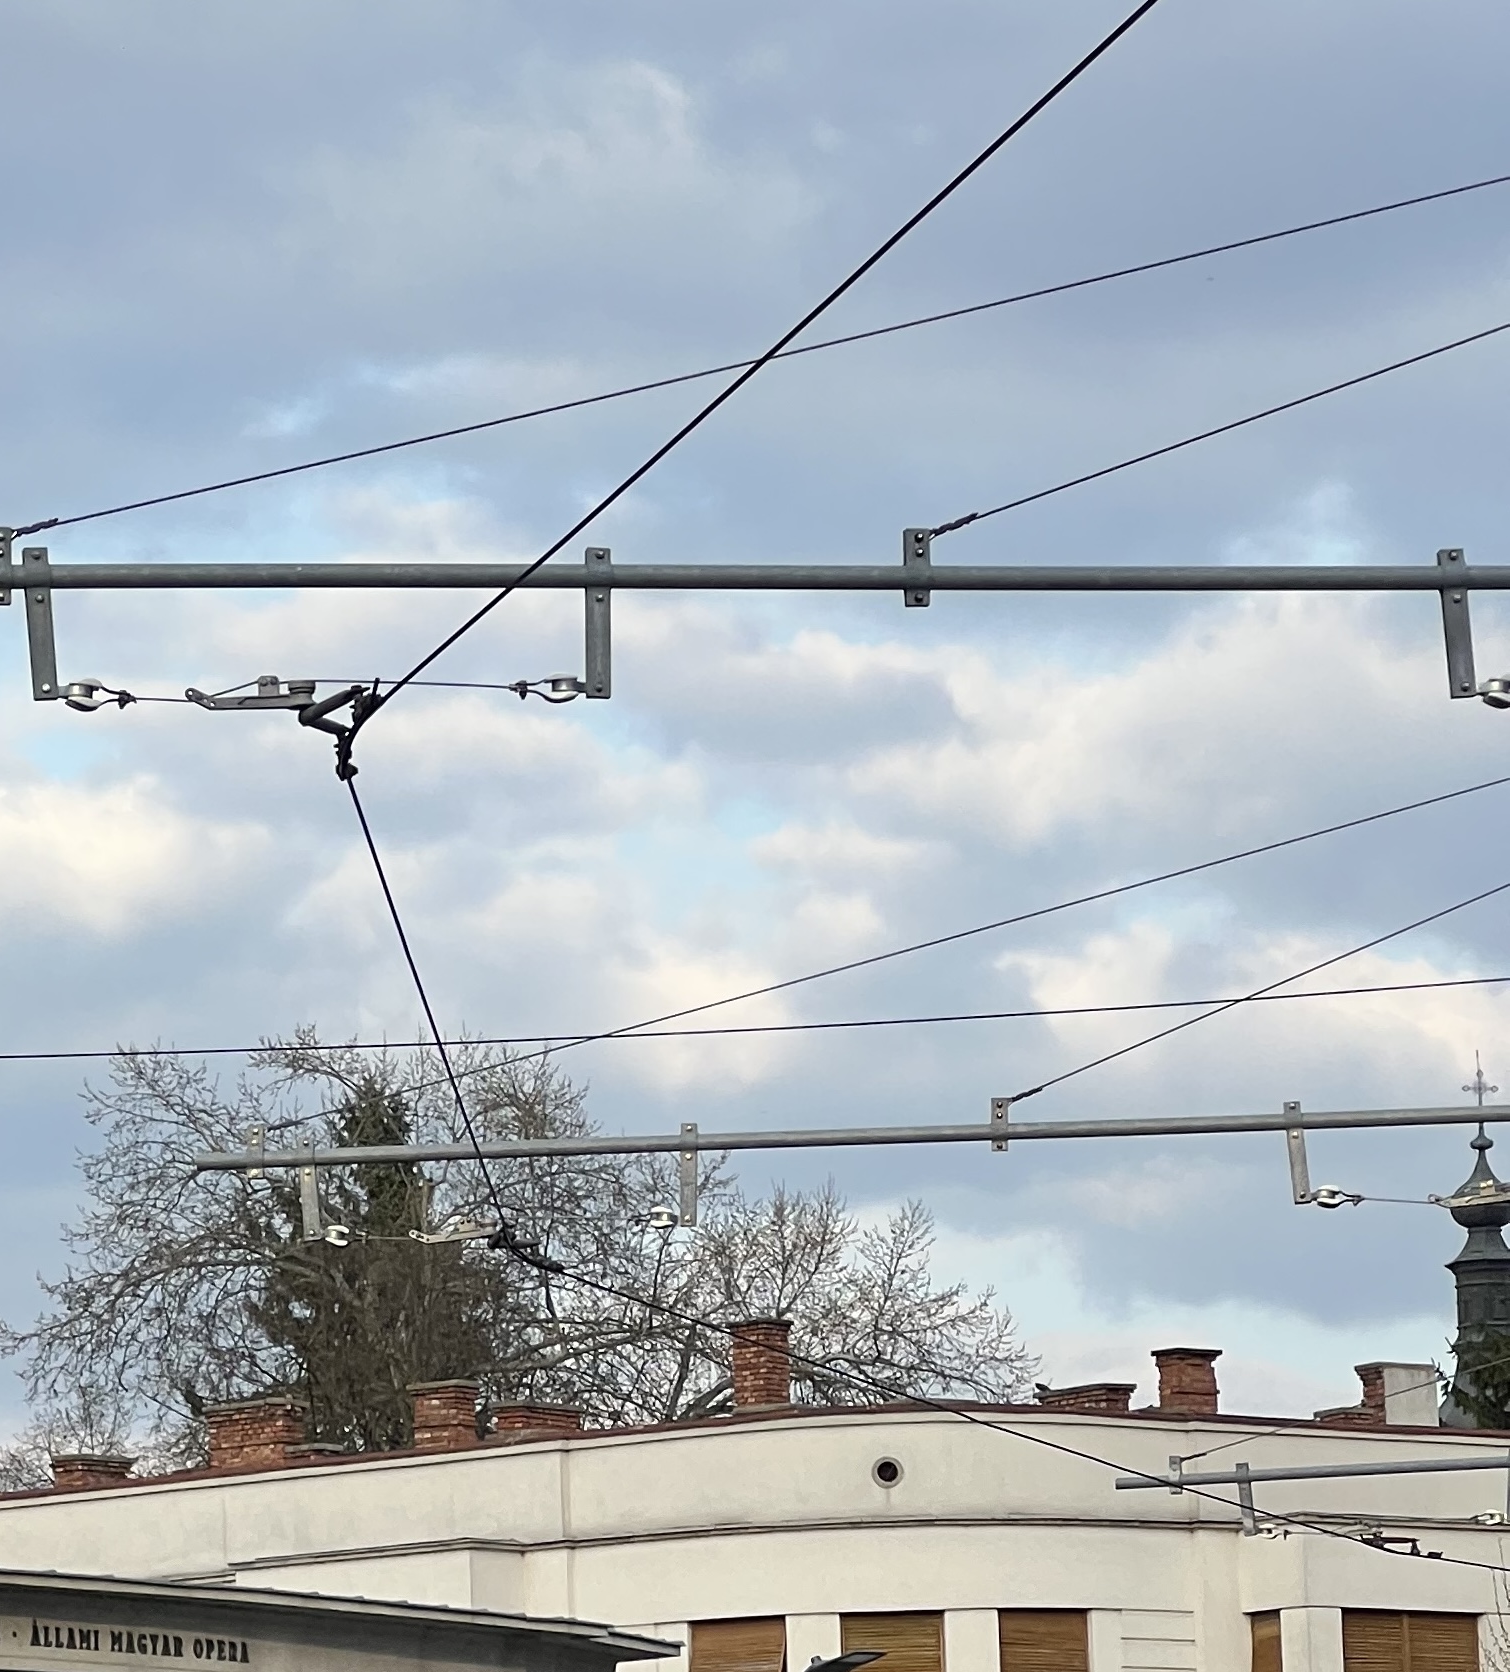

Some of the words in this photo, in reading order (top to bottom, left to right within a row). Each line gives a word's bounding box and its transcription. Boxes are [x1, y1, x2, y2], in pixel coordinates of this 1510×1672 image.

[30, 1618, 100, 1651] ÁLLAMI
[110, 1630, 184, 1658] MAGYAR
[192, 1637, 250, 1664] OPERA
